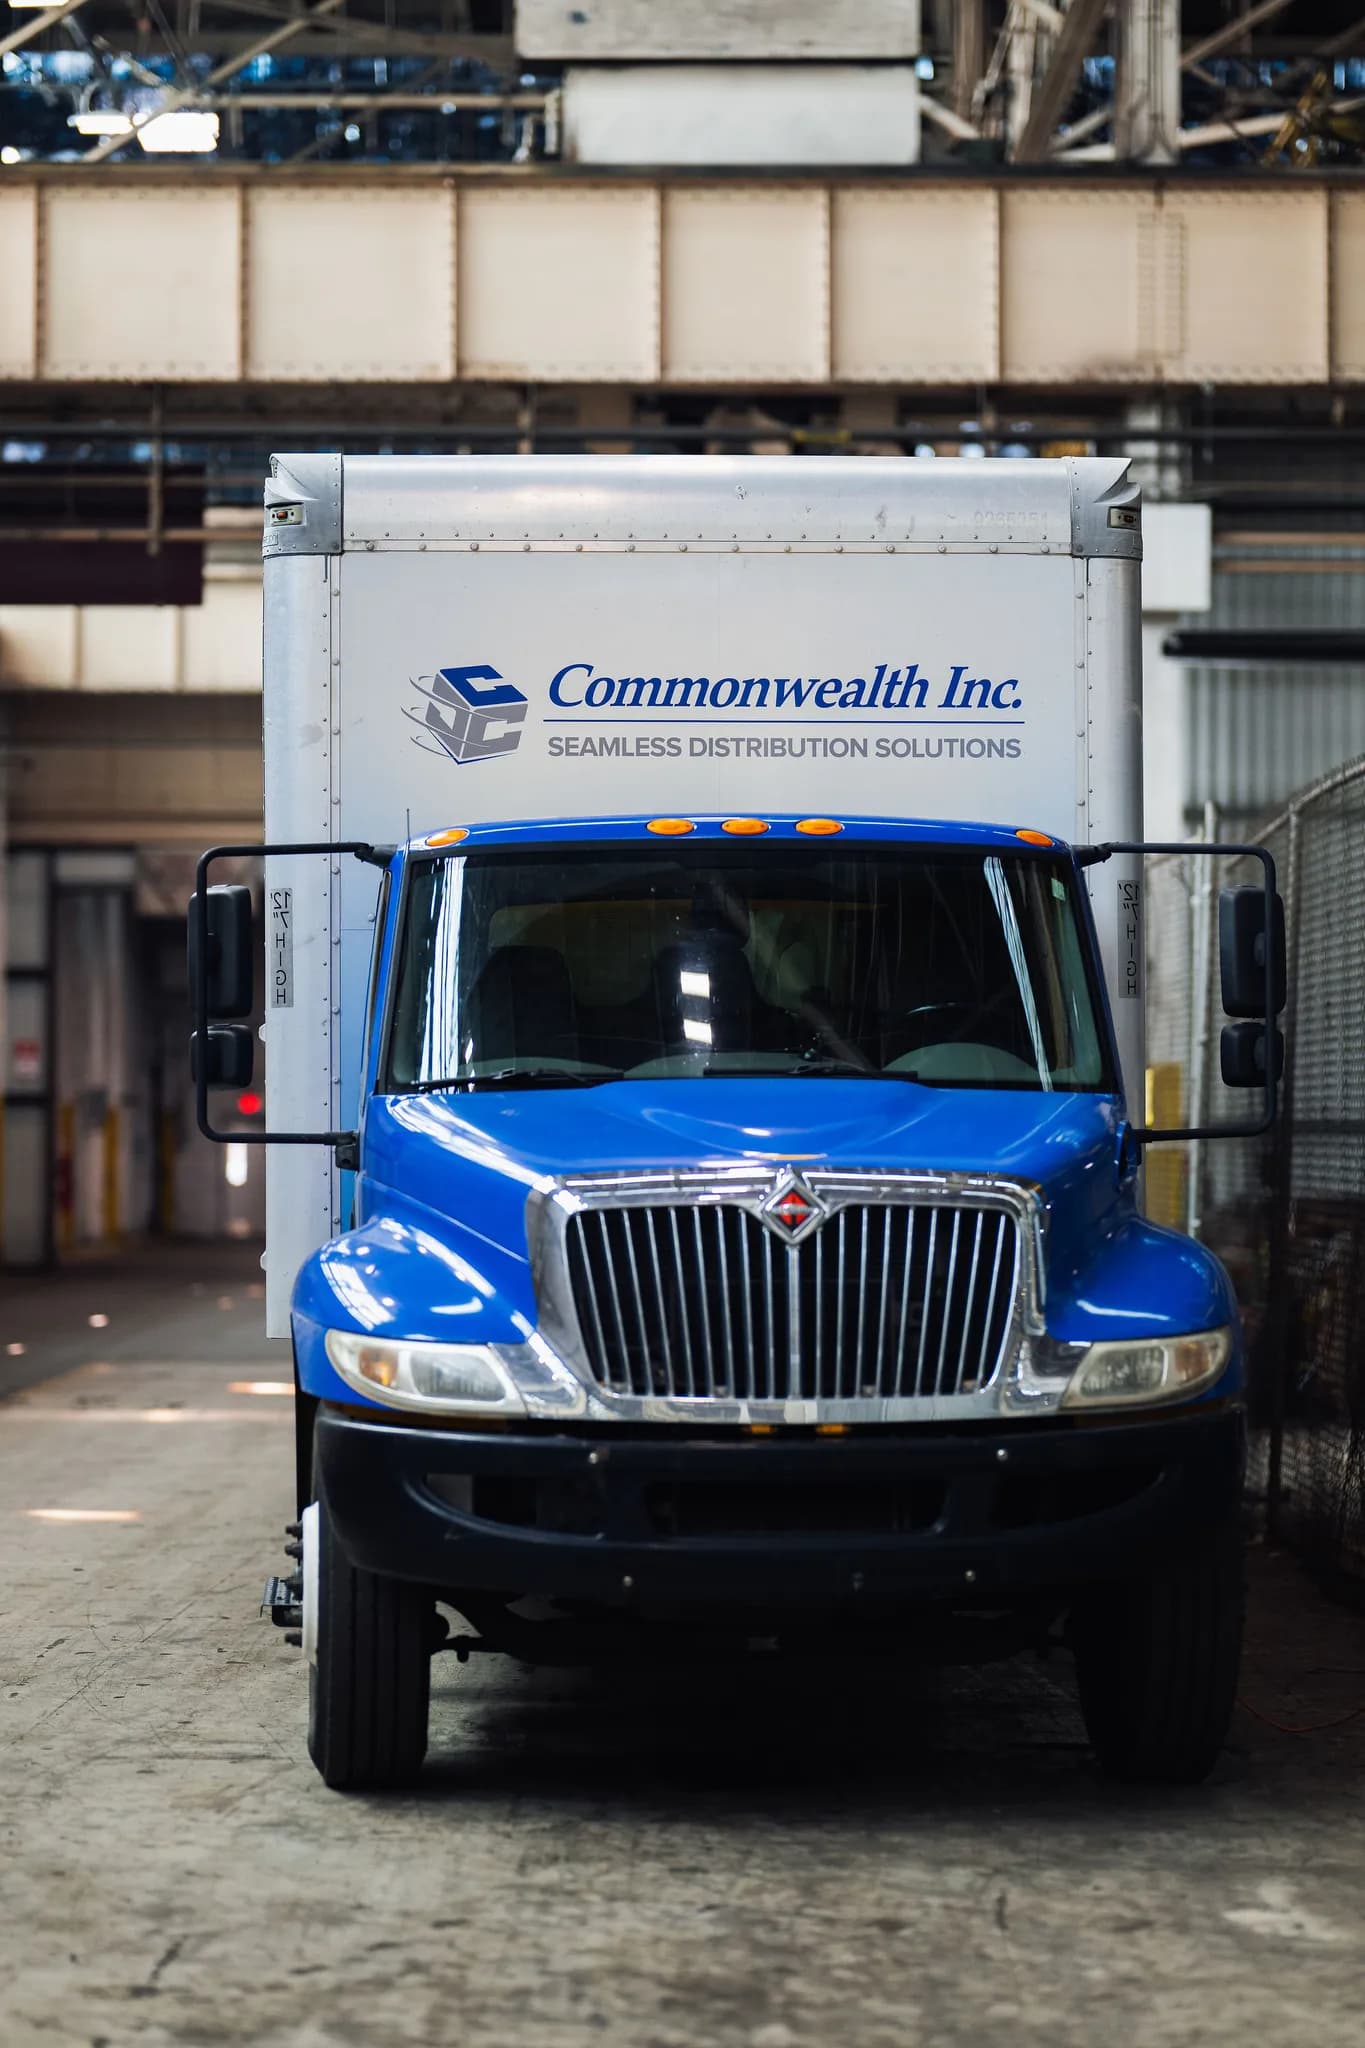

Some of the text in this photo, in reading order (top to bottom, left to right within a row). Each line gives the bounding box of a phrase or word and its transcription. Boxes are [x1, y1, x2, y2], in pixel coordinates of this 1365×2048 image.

[549, 664, 1022, 709] Commonwealth Inc.
[548, 737, 1022, 758] SEAMLESS DISTRIBUTION SOLUTIONS
